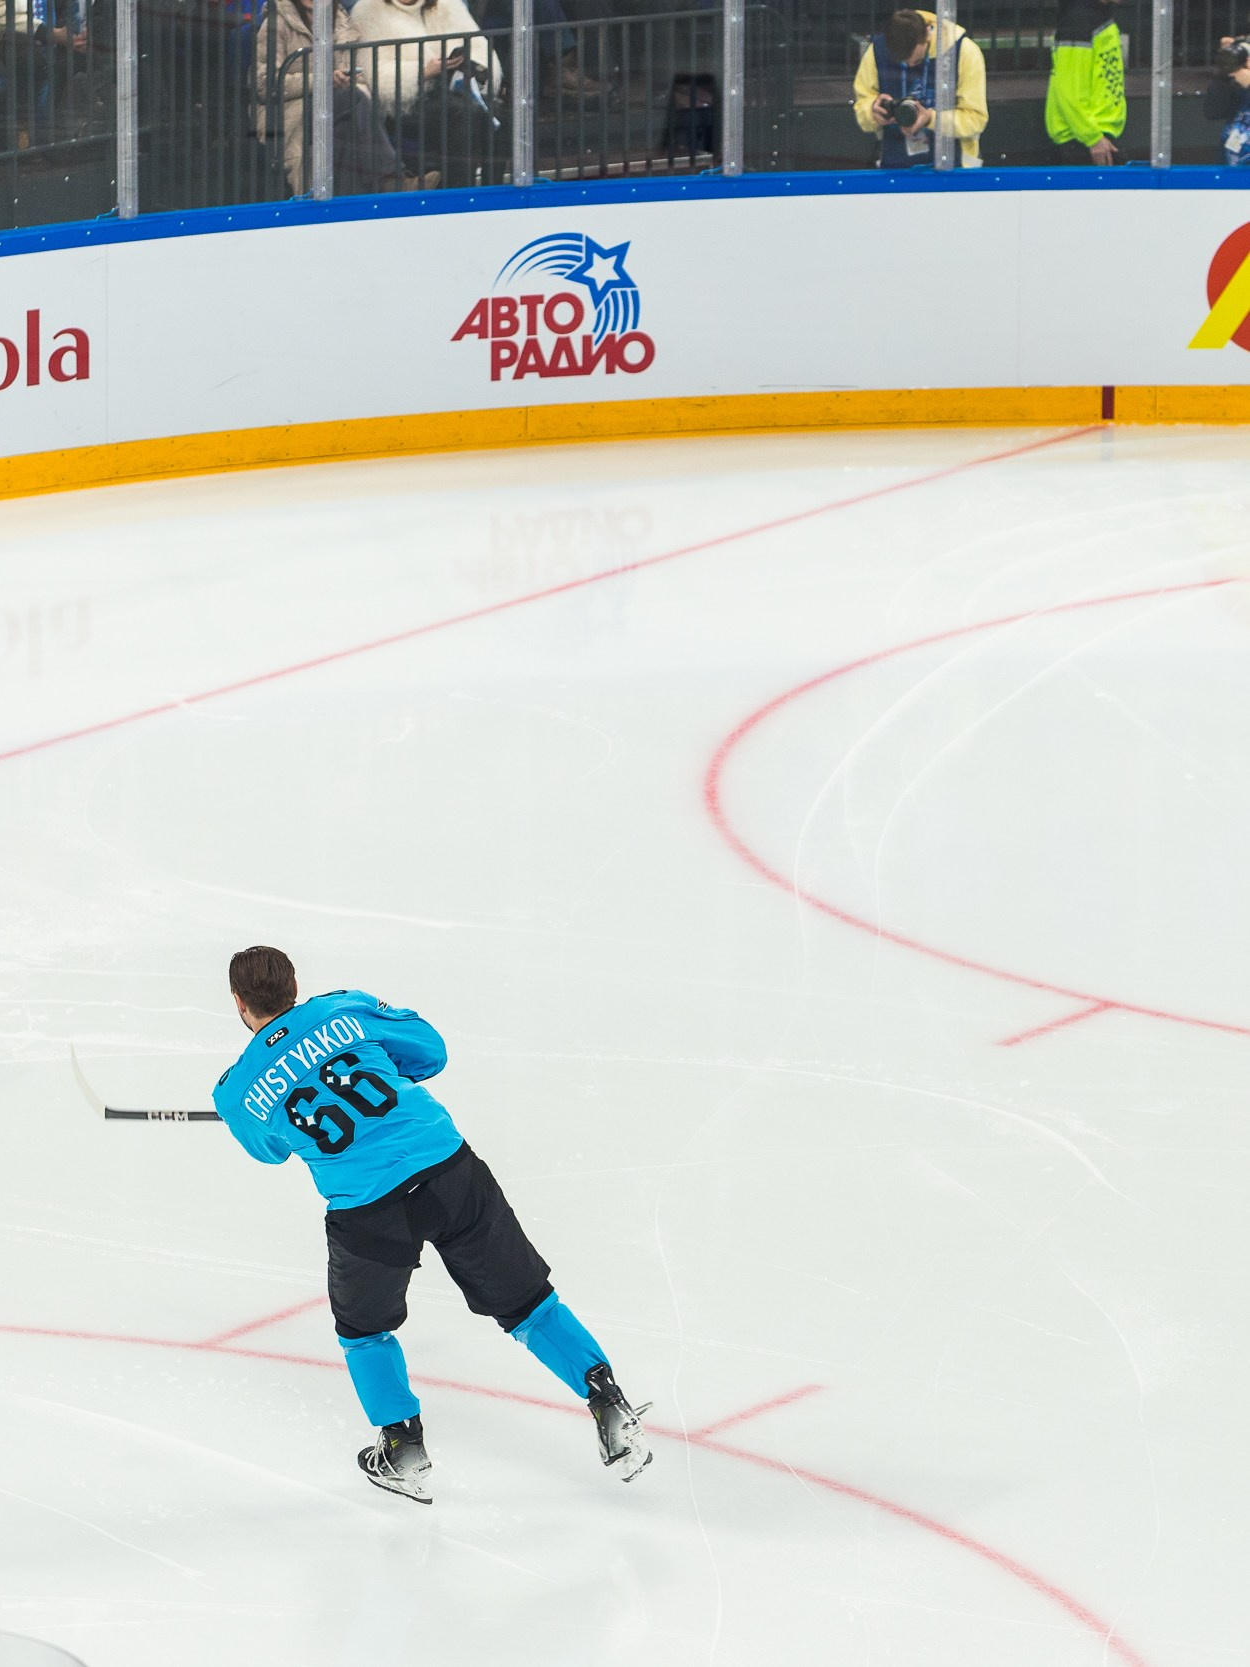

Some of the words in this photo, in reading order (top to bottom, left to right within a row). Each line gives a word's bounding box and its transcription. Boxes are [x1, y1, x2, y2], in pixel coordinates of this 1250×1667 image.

[450, 292, 585, 341] АВТО
[490, 331, 656, 382] РАДИО
[244, 1014, 366, 1122] CHISTYAKOV
[283, 1051, 398, 1155] 66
